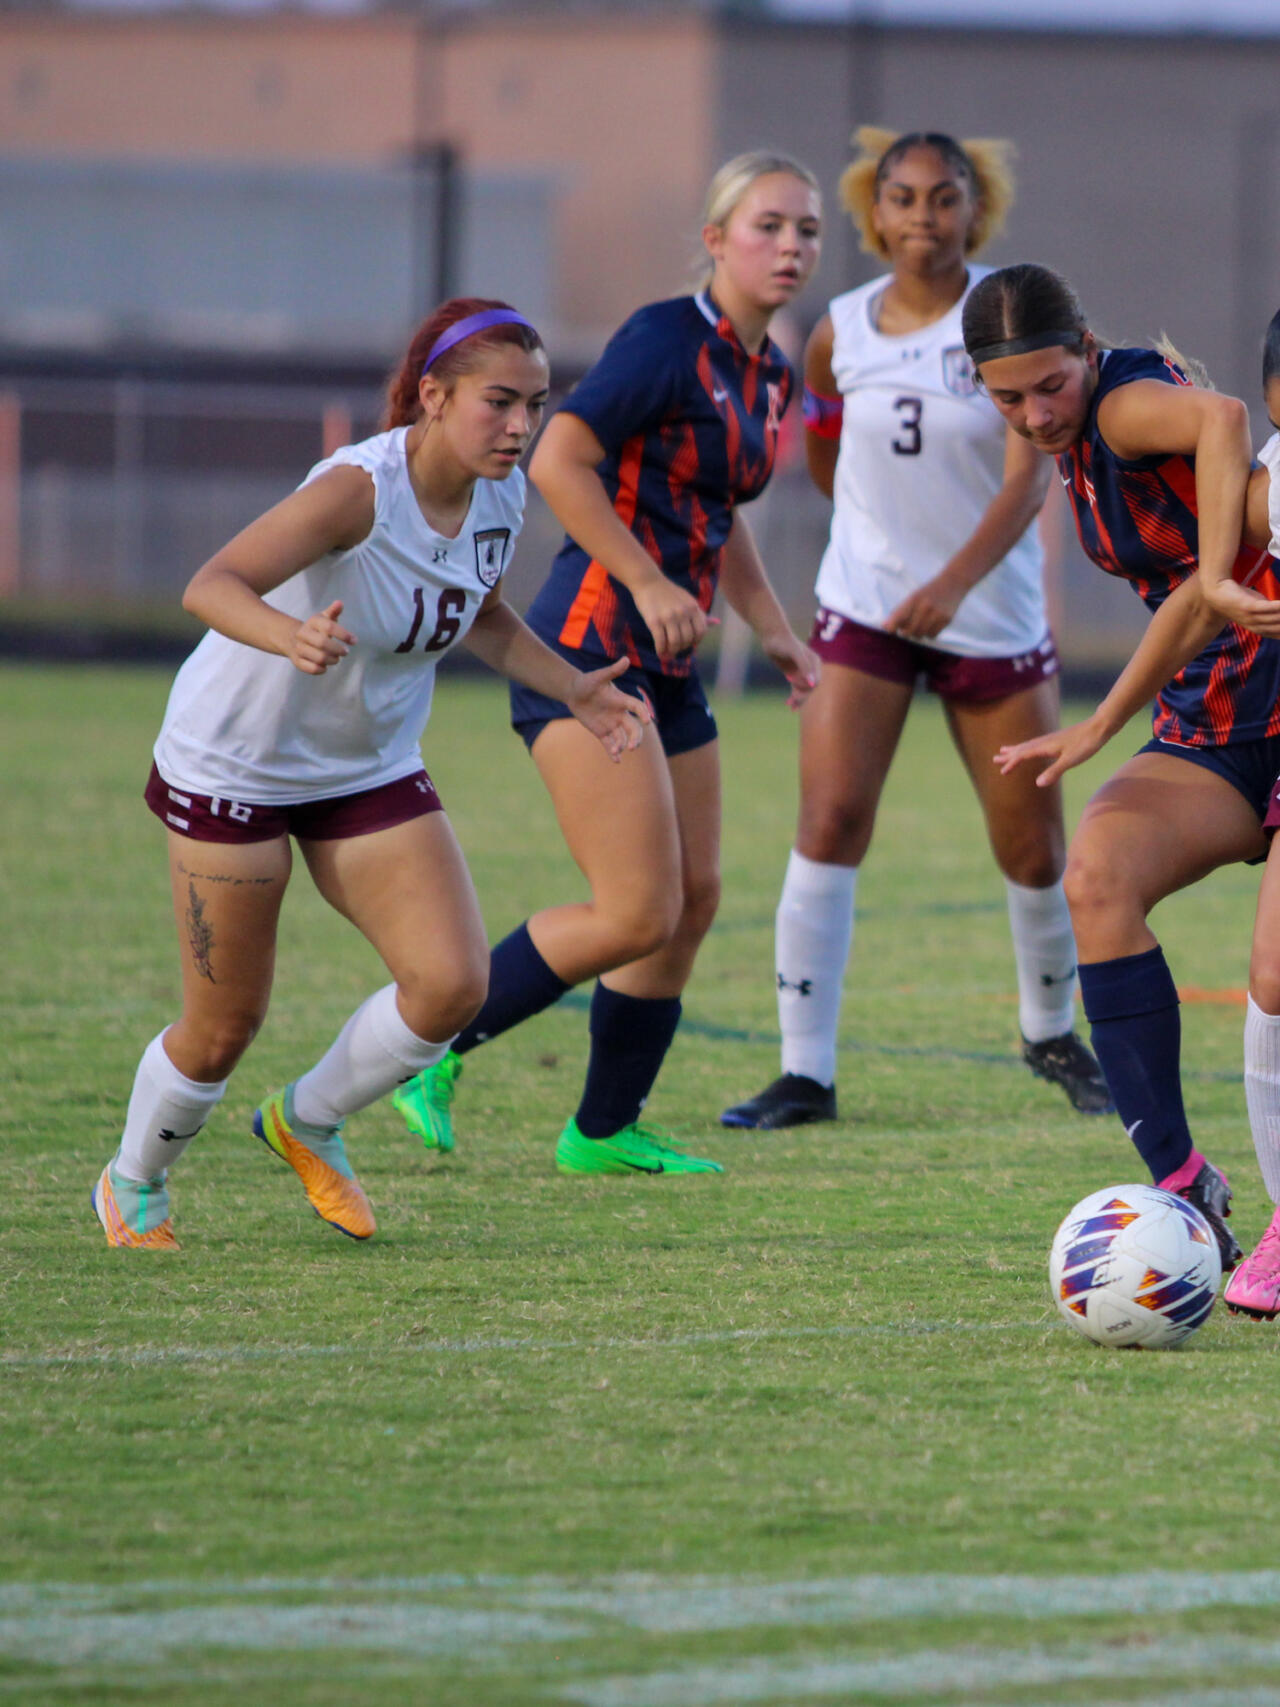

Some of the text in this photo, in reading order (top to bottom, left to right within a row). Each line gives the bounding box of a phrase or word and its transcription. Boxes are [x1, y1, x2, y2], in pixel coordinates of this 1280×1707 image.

[892, 397, 922, 456] 3
[394, 588, 466, 653] 16
[821, 612, 842, 641] 3
[210, 796, 252, 823] 16
